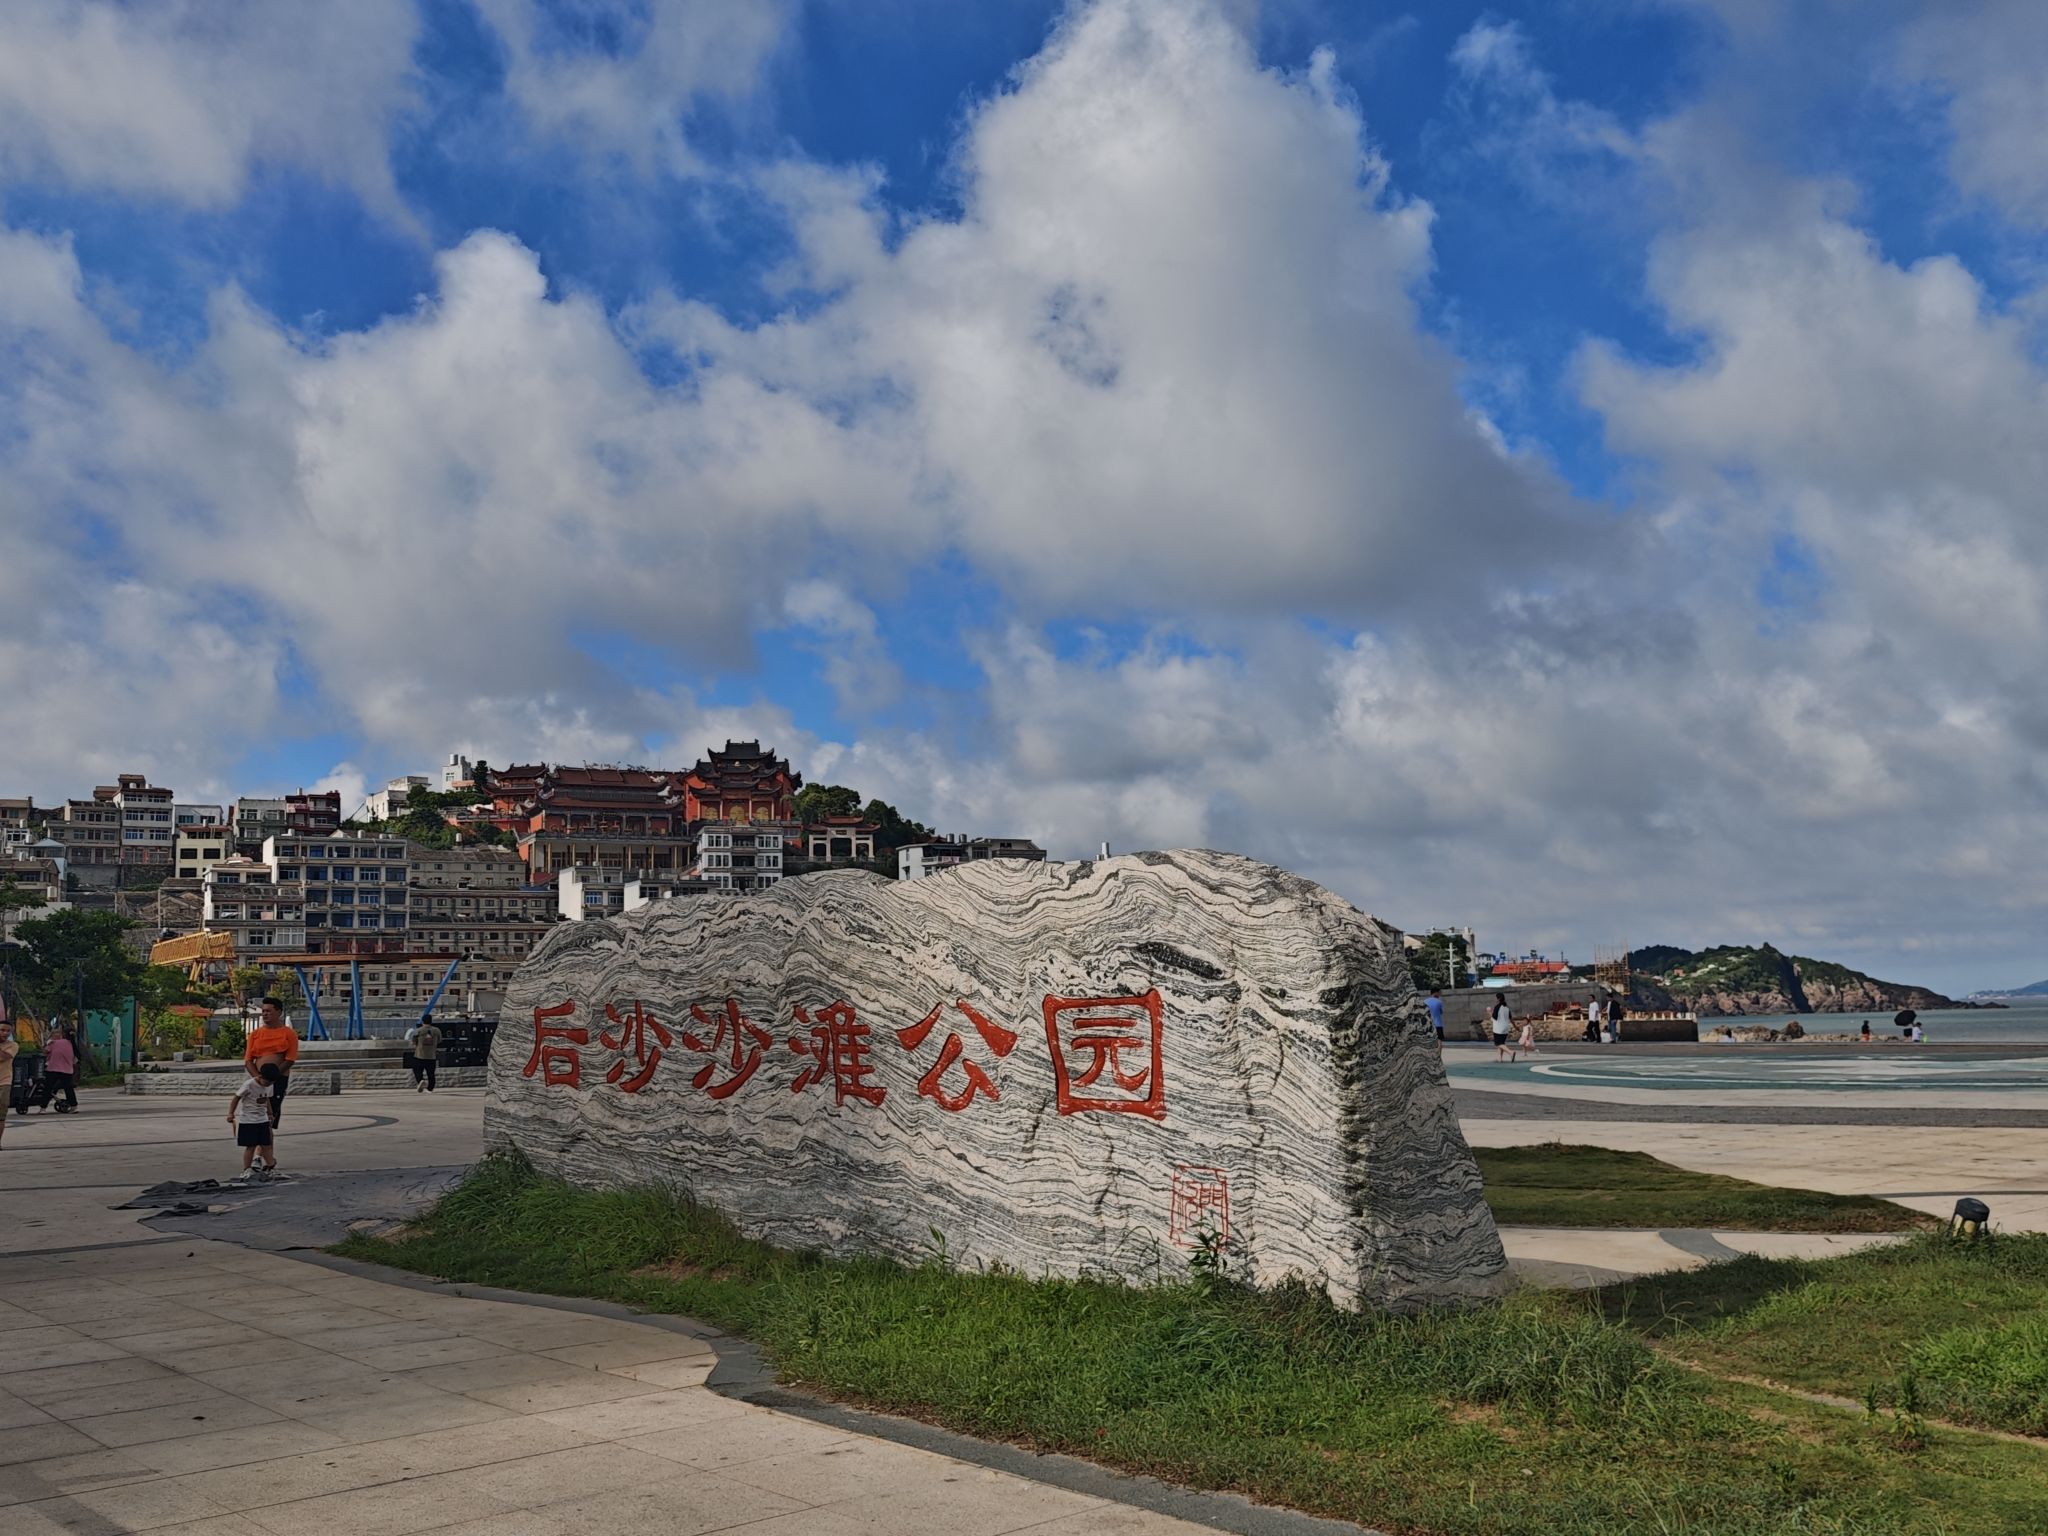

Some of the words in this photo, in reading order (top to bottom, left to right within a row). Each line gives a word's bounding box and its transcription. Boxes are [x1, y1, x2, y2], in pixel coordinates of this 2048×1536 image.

[523, 988, 1167, 1121] 后沙沙滩公园
